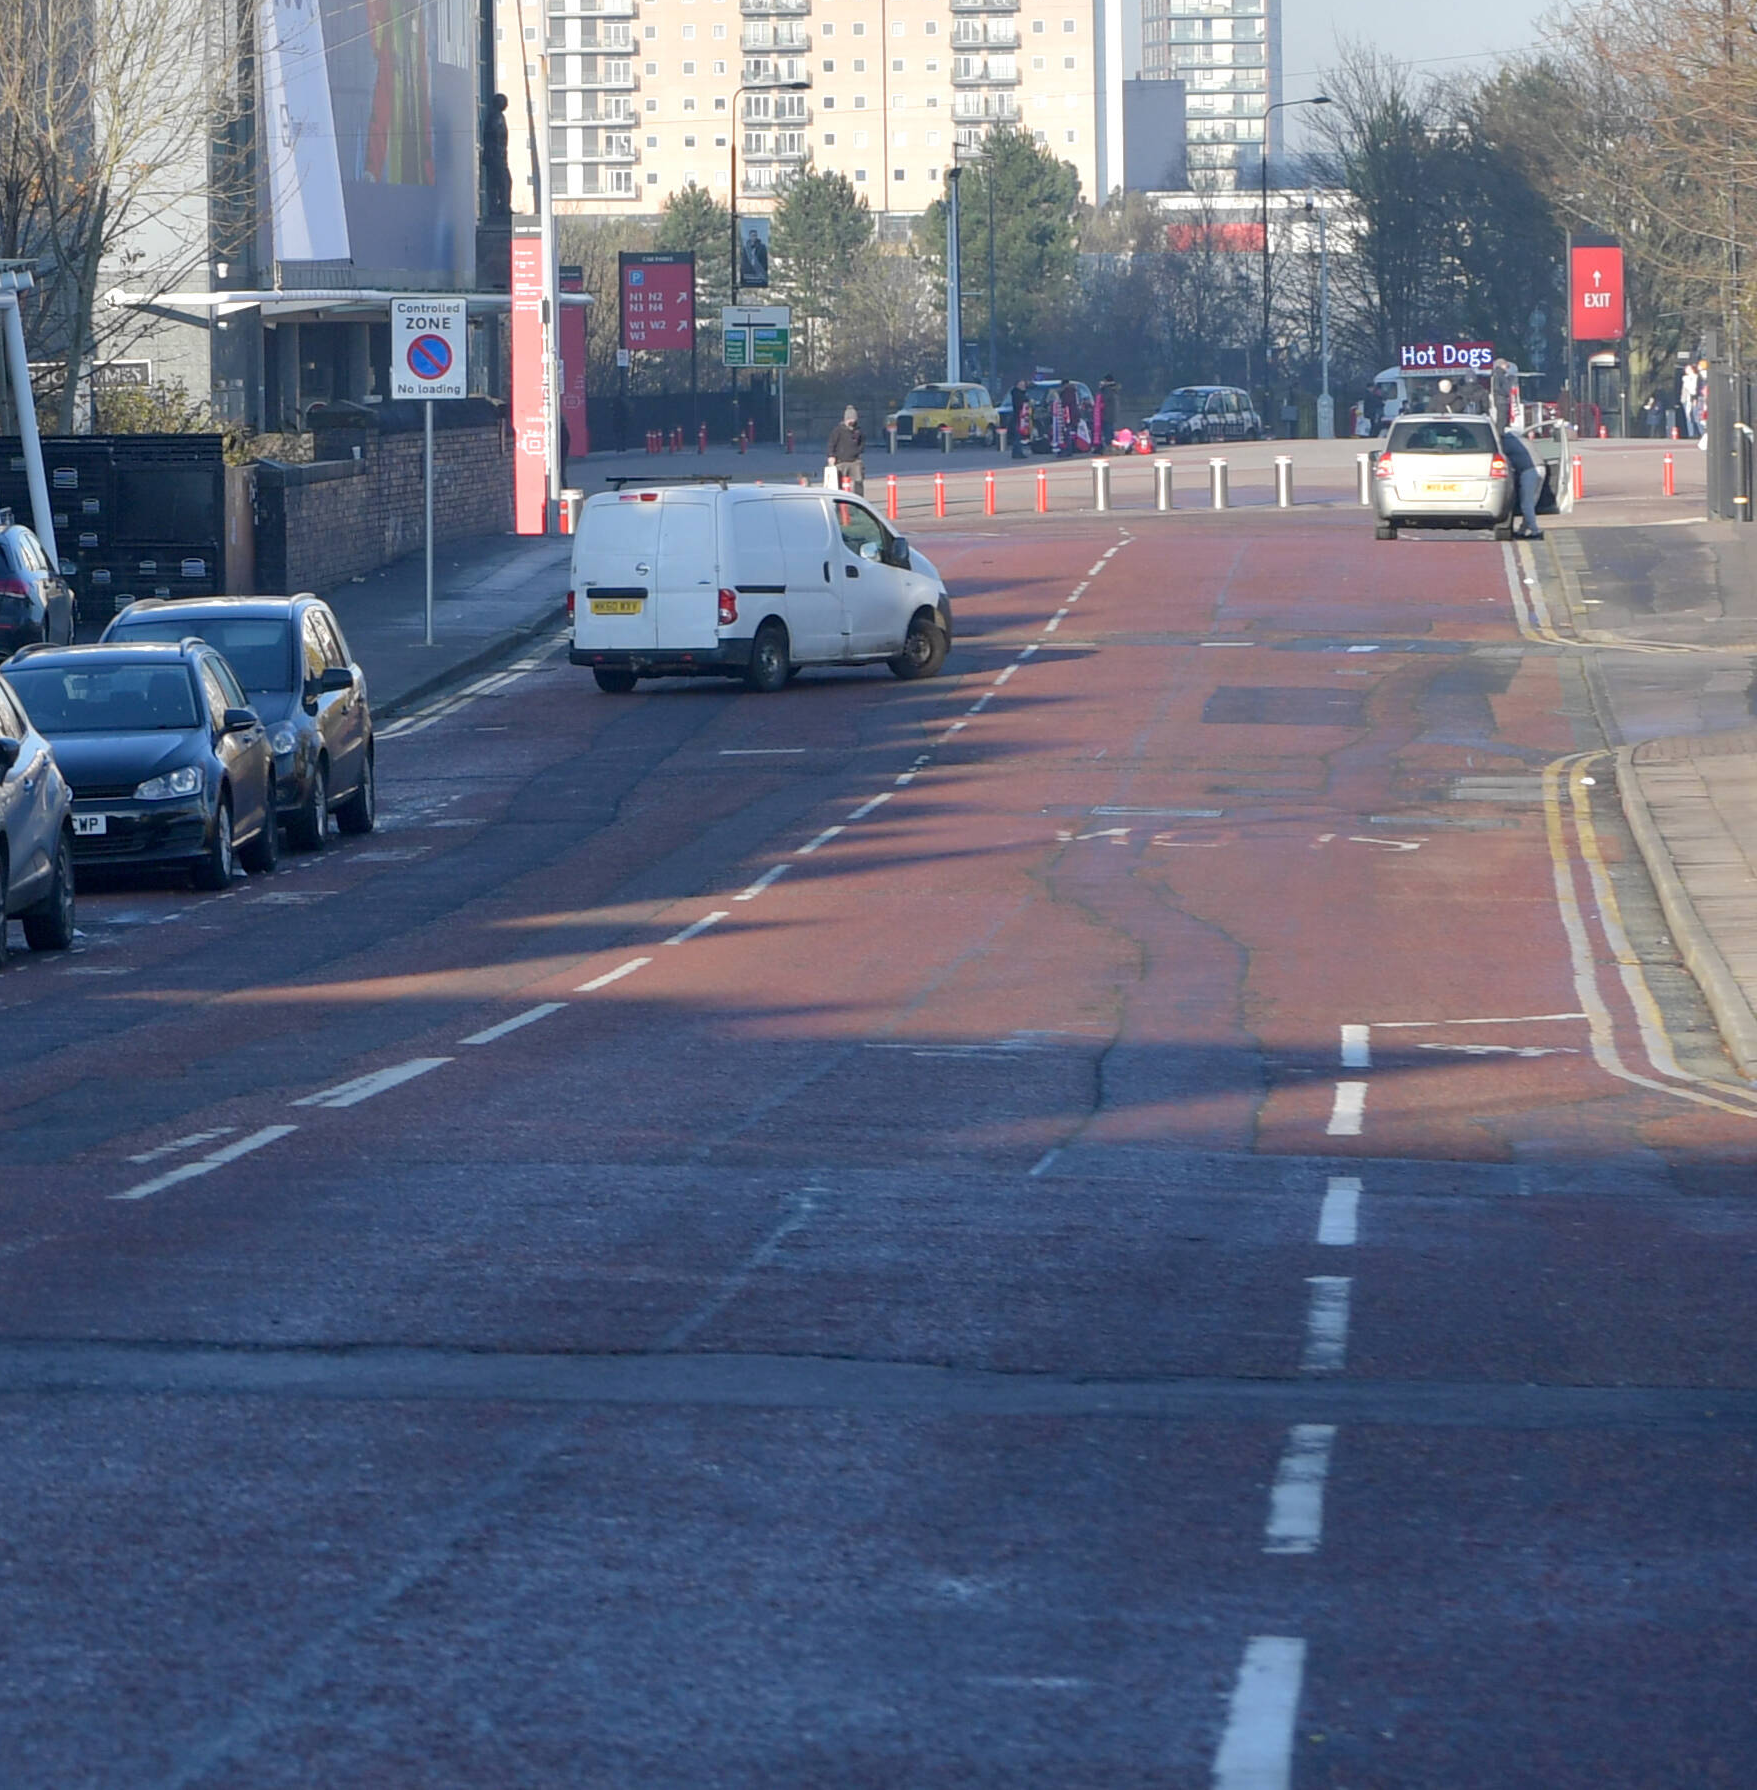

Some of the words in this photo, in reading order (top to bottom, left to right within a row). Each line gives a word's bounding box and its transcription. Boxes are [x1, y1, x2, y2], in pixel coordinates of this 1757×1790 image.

[632, 272, 641, 283] P
[629, 293, 643, 302] N1
[648, 293, 663, 302] N2
[1584, 292, 1611, 308] EXIT
[397, 303, 460, 313] Controlled
[629, 303, 644, 312] N3
[648, 303, 664, 312] N4
[405, 317, 451, 330] ZONE
[629, 321, 645, 330] W1
[649, 321, 666, 330] W2
[629, 332, 646, 341] W3
[1401, 345, 1436, 366] Hot
[1443, 344, 1492, 367] Dogs
[398, 384, 414, 393] No
[418, 384, 461, 395] loading
